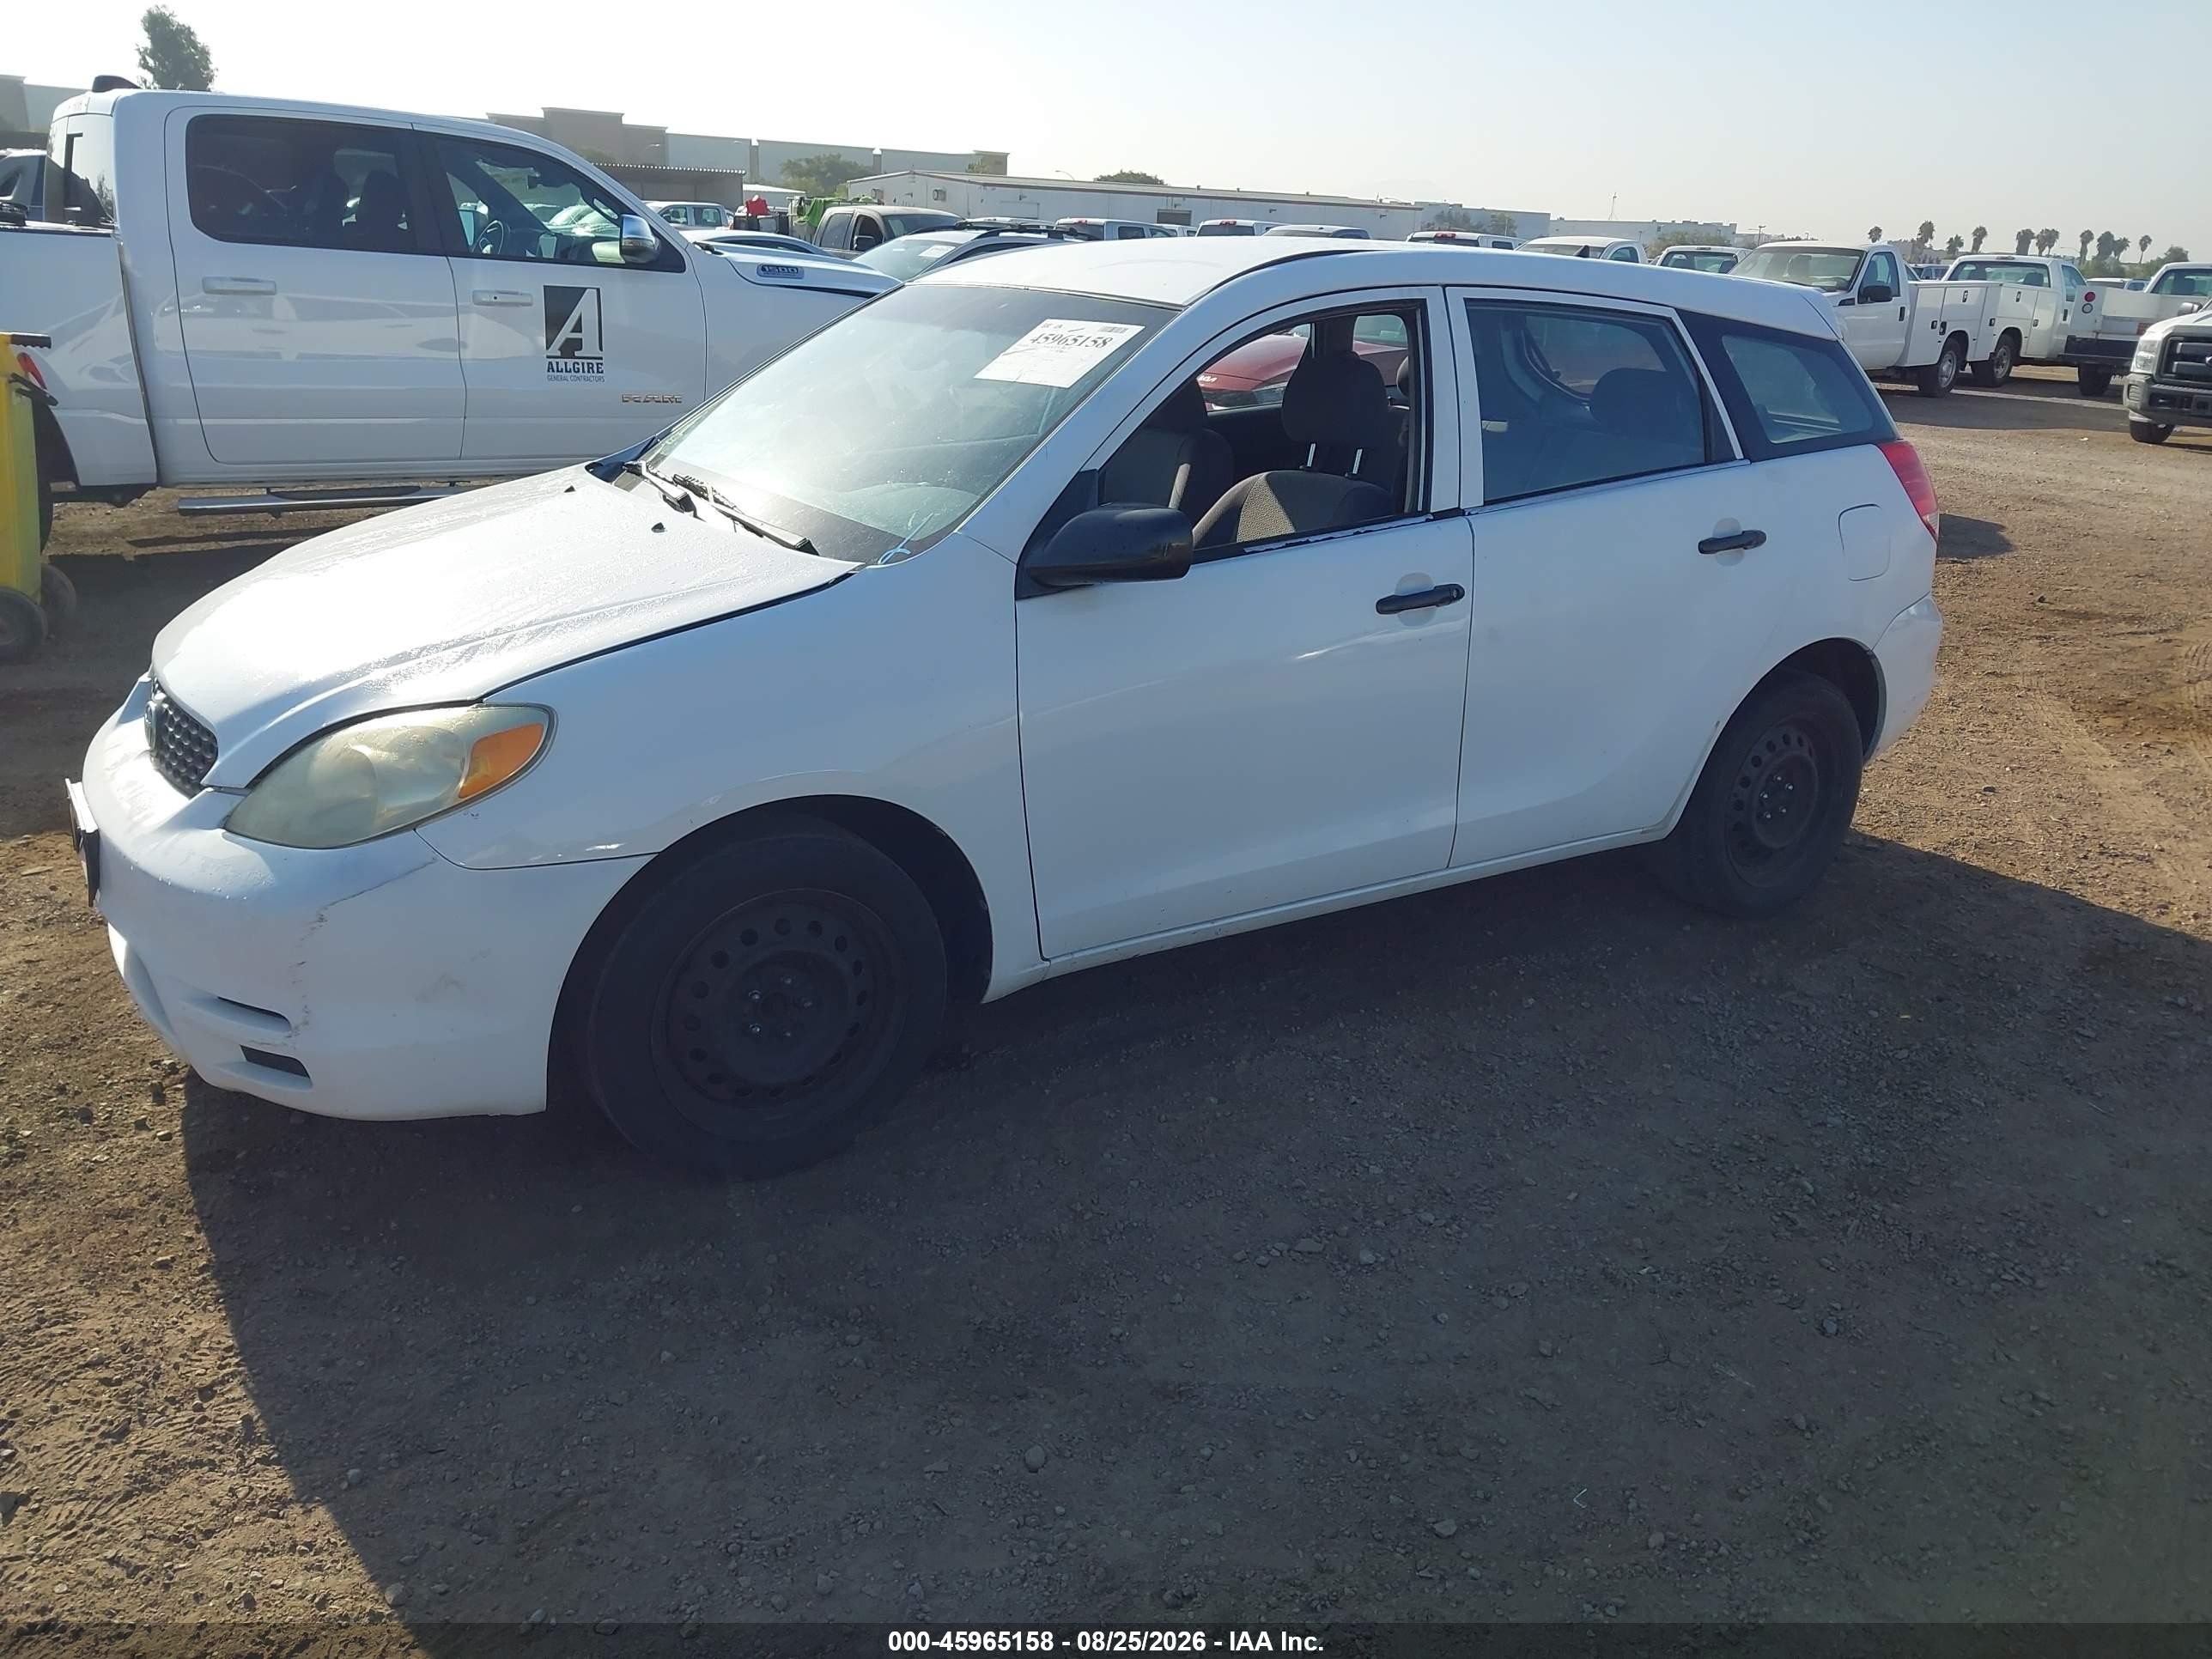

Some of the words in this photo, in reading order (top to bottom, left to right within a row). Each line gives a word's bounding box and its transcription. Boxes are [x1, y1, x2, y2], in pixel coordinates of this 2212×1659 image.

[762, 265, 799, 274] 1500
[547, 288, 604, 357] A
[1030, 333, 1114, 348] 45965158
[547, 361, 605, 374] ALLGIRE
[622, 394, 684, 404] RAM
